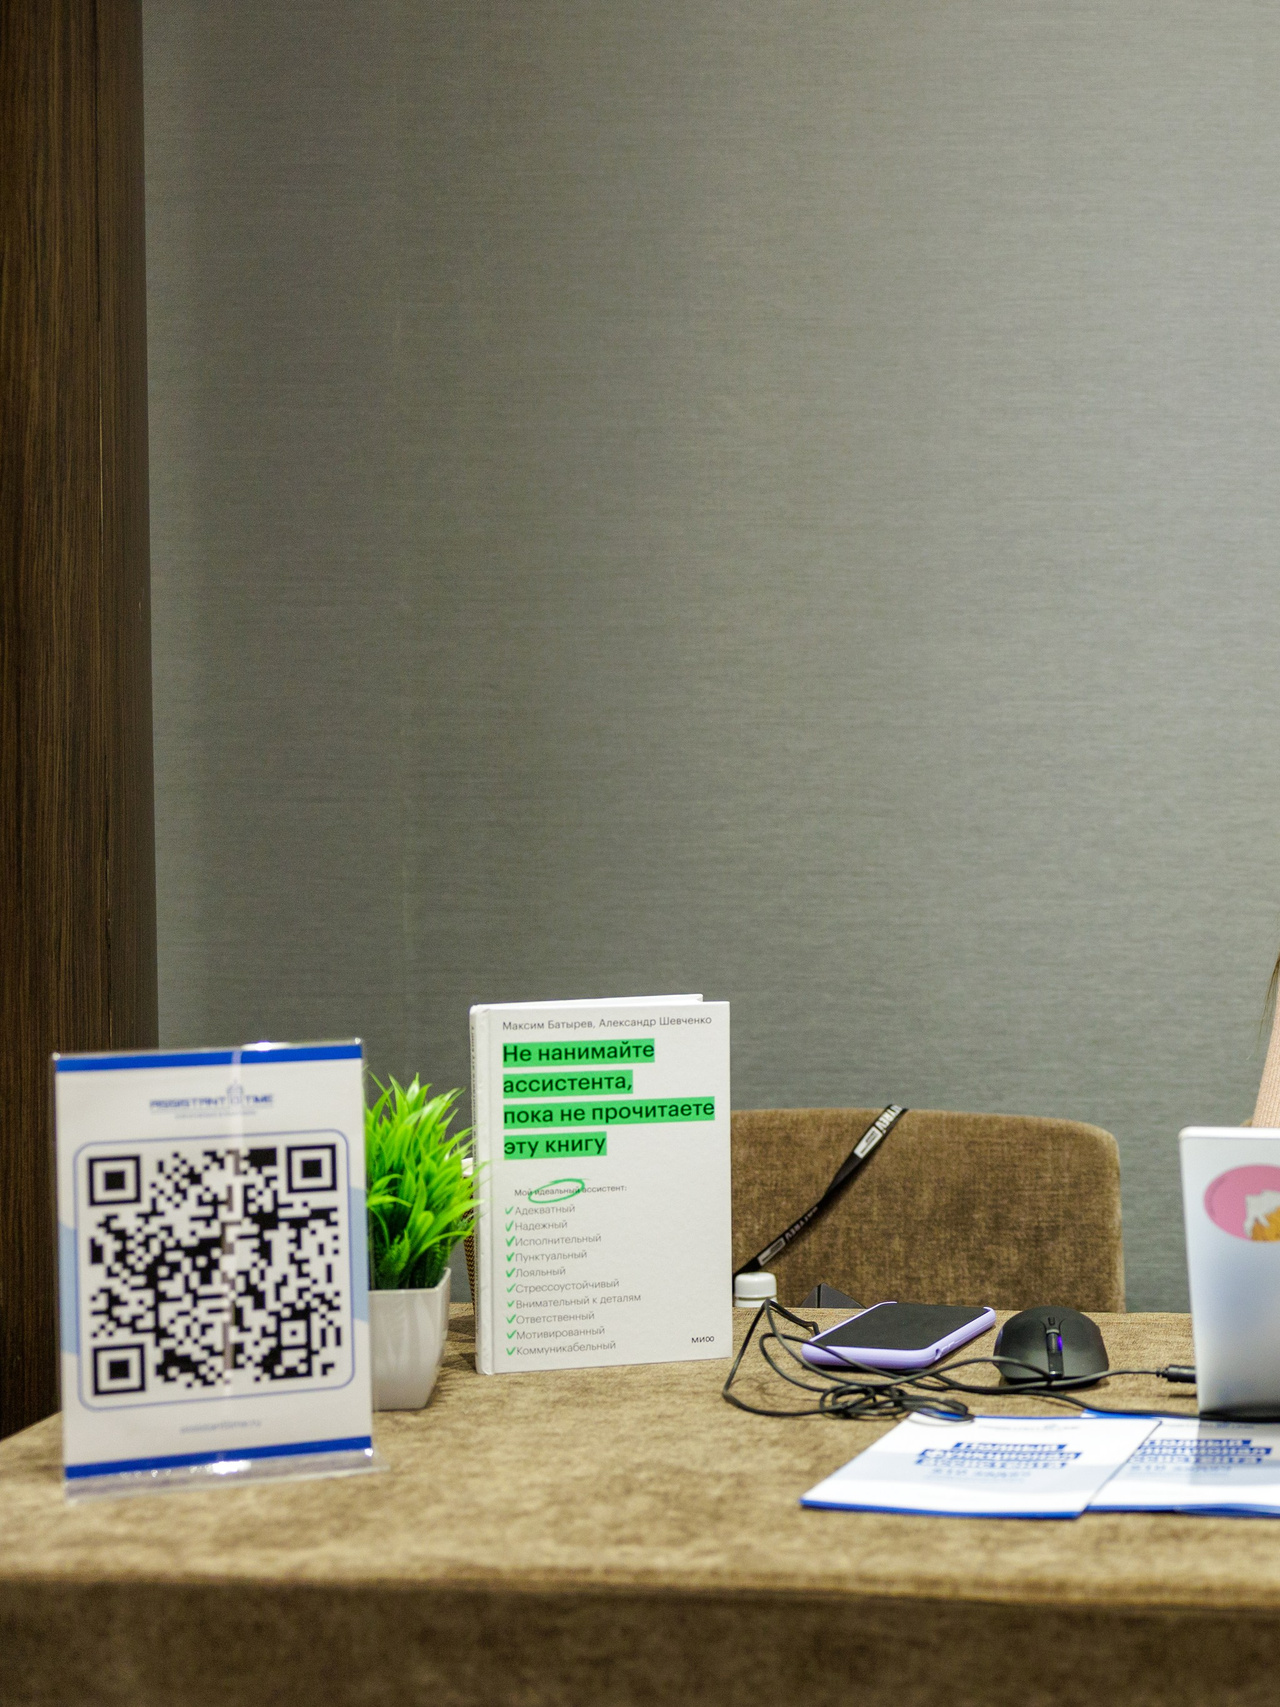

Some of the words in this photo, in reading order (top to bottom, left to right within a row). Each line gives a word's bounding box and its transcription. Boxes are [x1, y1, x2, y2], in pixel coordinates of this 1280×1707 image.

[502, 1020, 545, 1032] Максим
[547, 1018, 597, 1031] Батырев,
[598, 1017, 657, 1028] Александр
[659, 1015, 713, 1027] Шевченко
[503, 1044, 532, 1063] Не
[538, 1039, 655, 1062] нанимайте
[503, 1075, 633, 1094] ассистента,
[504, 1109, 554, 1125] пока
[560, 1107, 587, 1122] не
[591, 1101, 715, 1124] прочитаете
[503, 1141, 540, 1158] эту
[545, 1136, 607, 1155] книгу
[514, 1187, 532, 1197] Мой
[534, 1185, 580, 1196] идеальный
[514, 1203, 576, 1216] Адекватный
[514, 1219, 568, 1232] Надежный
[514, 1233, 602, 1247] Исполнительный
[515, 1249, 588, 1264] Пунктуальный
[515, 1265, 566, 1278] Лояльный
[515, 1278, 620, 1295] Стрессоустойчивый
[515, 1295, 590, 1310] Внимательный
[599, 1293, 642, 1305] деталям
[515, 1310, 595, 1325] Ответственный
[516, 1325, 606, 1340] Мотивированный
[516, 1340, 617, 1357] Коммуникабельный
